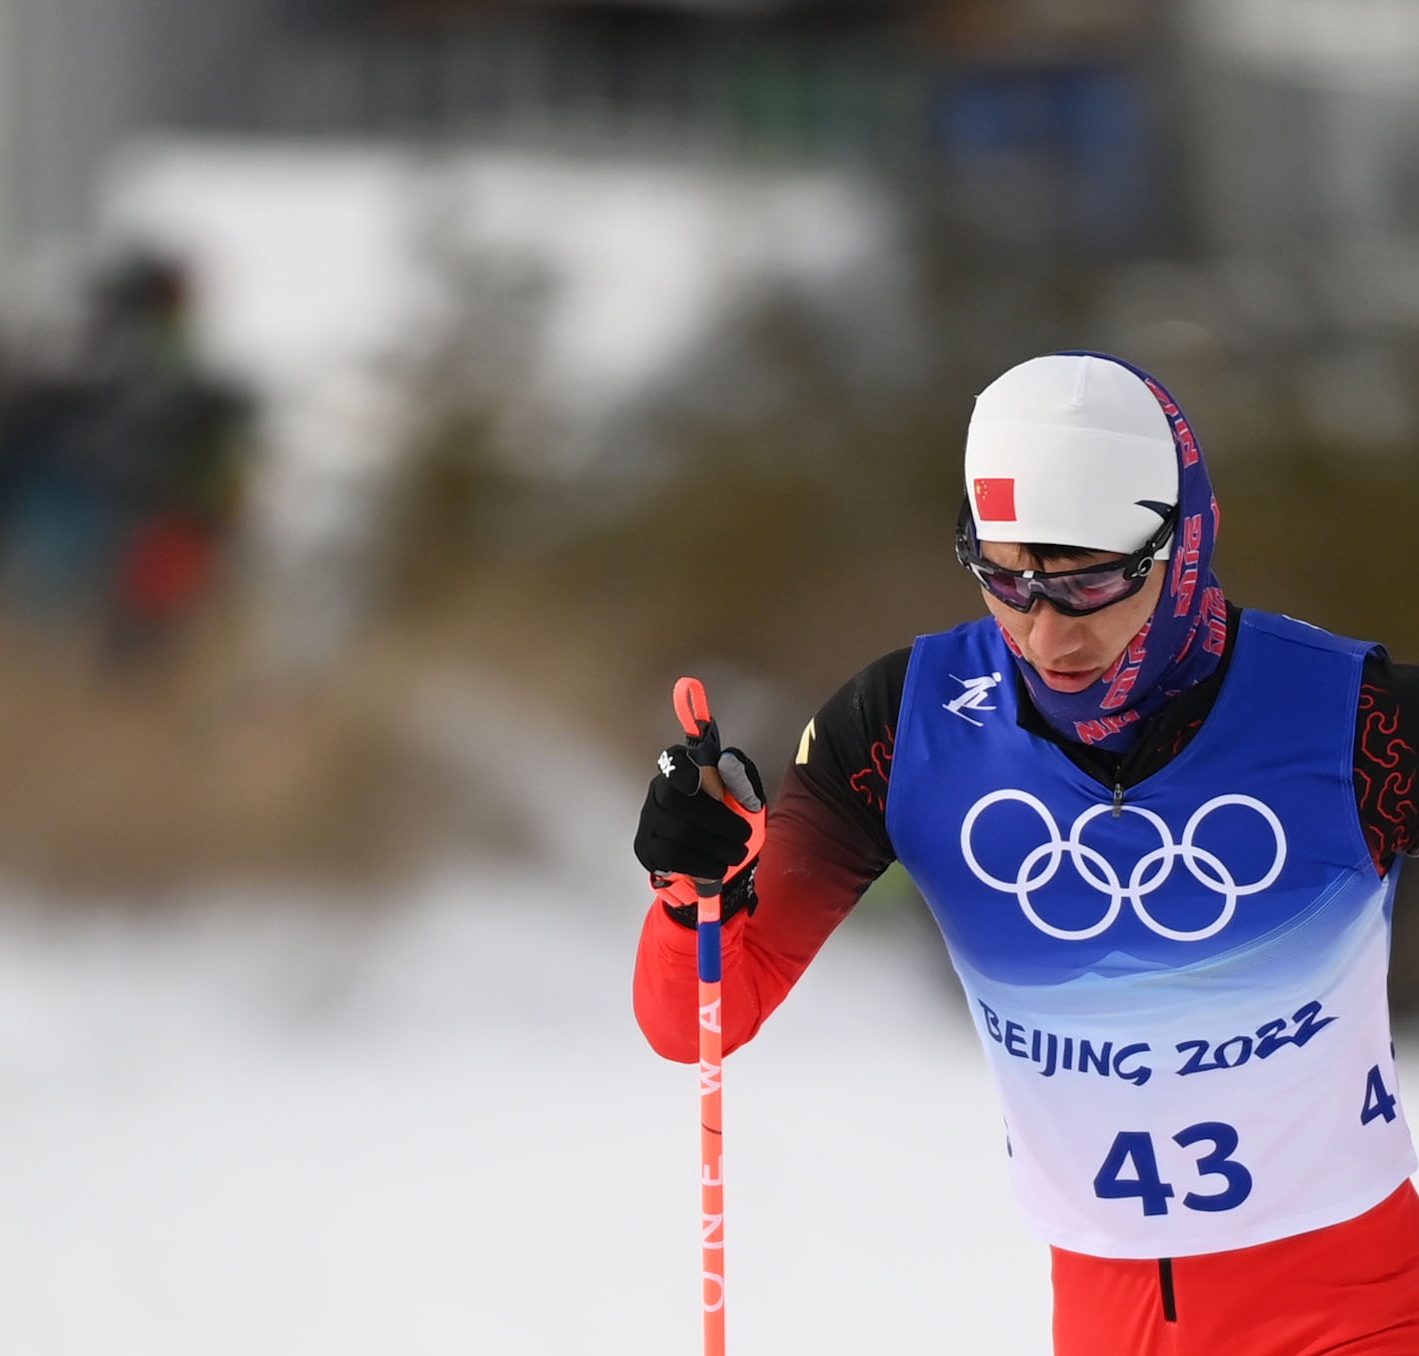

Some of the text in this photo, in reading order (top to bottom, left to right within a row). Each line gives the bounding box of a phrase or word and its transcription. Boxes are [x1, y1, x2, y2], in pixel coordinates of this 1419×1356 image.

[977, 998, 1340, 1086] BEIJING 2022
[1093, 1121, 1252, 1216] 43
